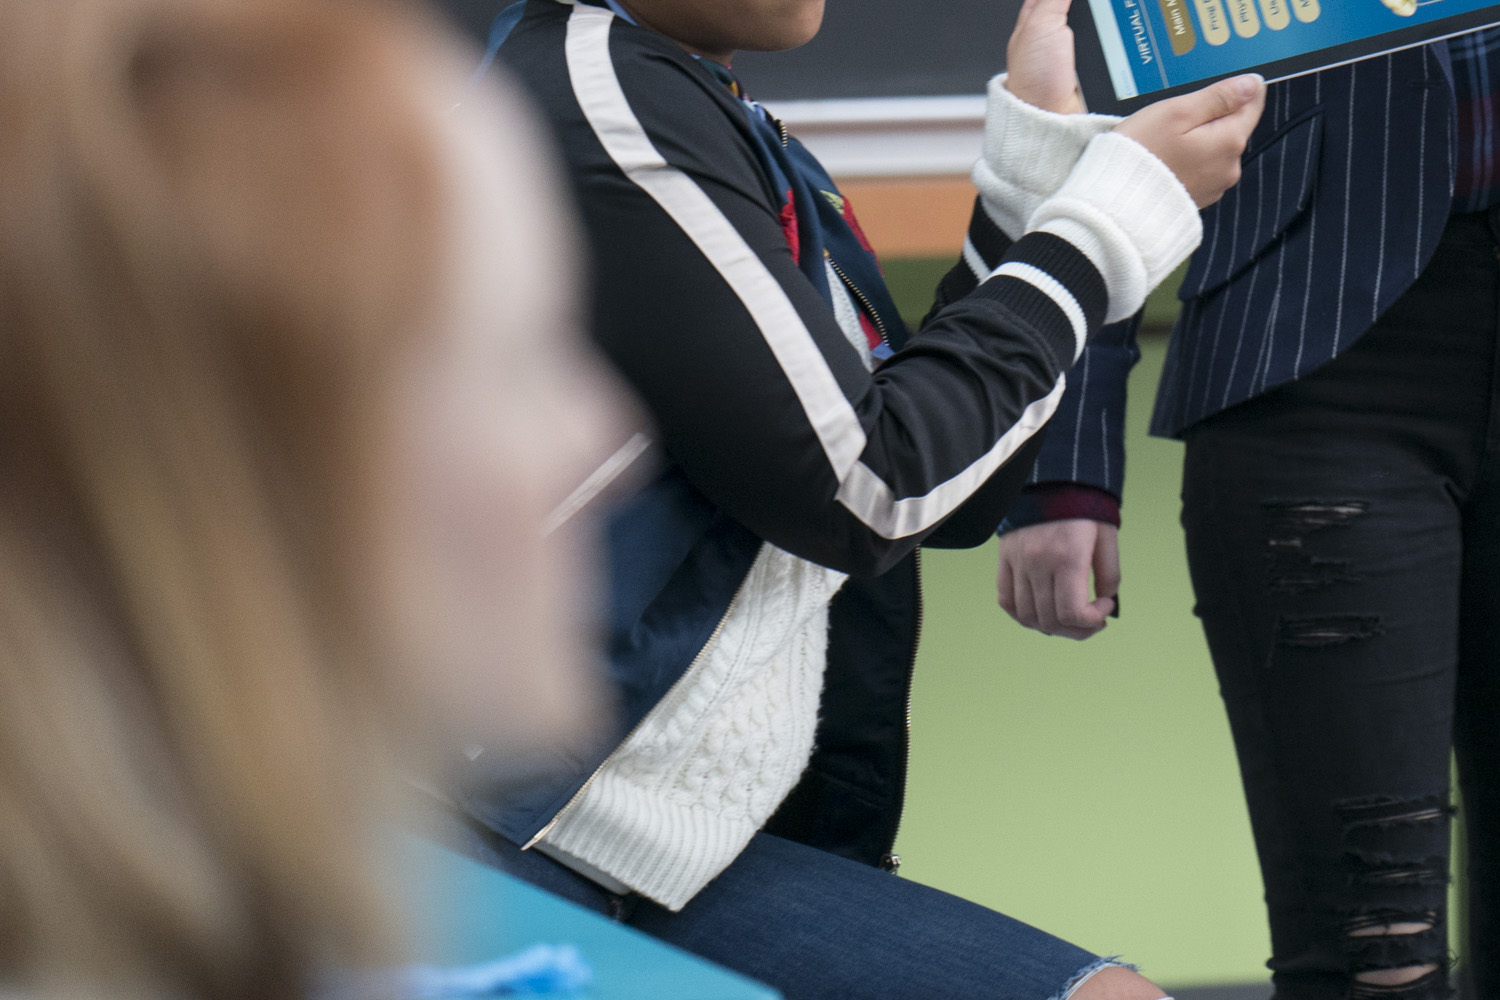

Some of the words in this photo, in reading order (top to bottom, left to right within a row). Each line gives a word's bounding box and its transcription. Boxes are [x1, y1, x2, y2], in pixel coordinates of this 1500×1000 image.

[1171, 7, 1187, 36] Main
[1206, 5, 1220, 31] Frog
[1269, 0, 1281, 16] Us
[1128, 8, 1154, 65] VIRTUAL
